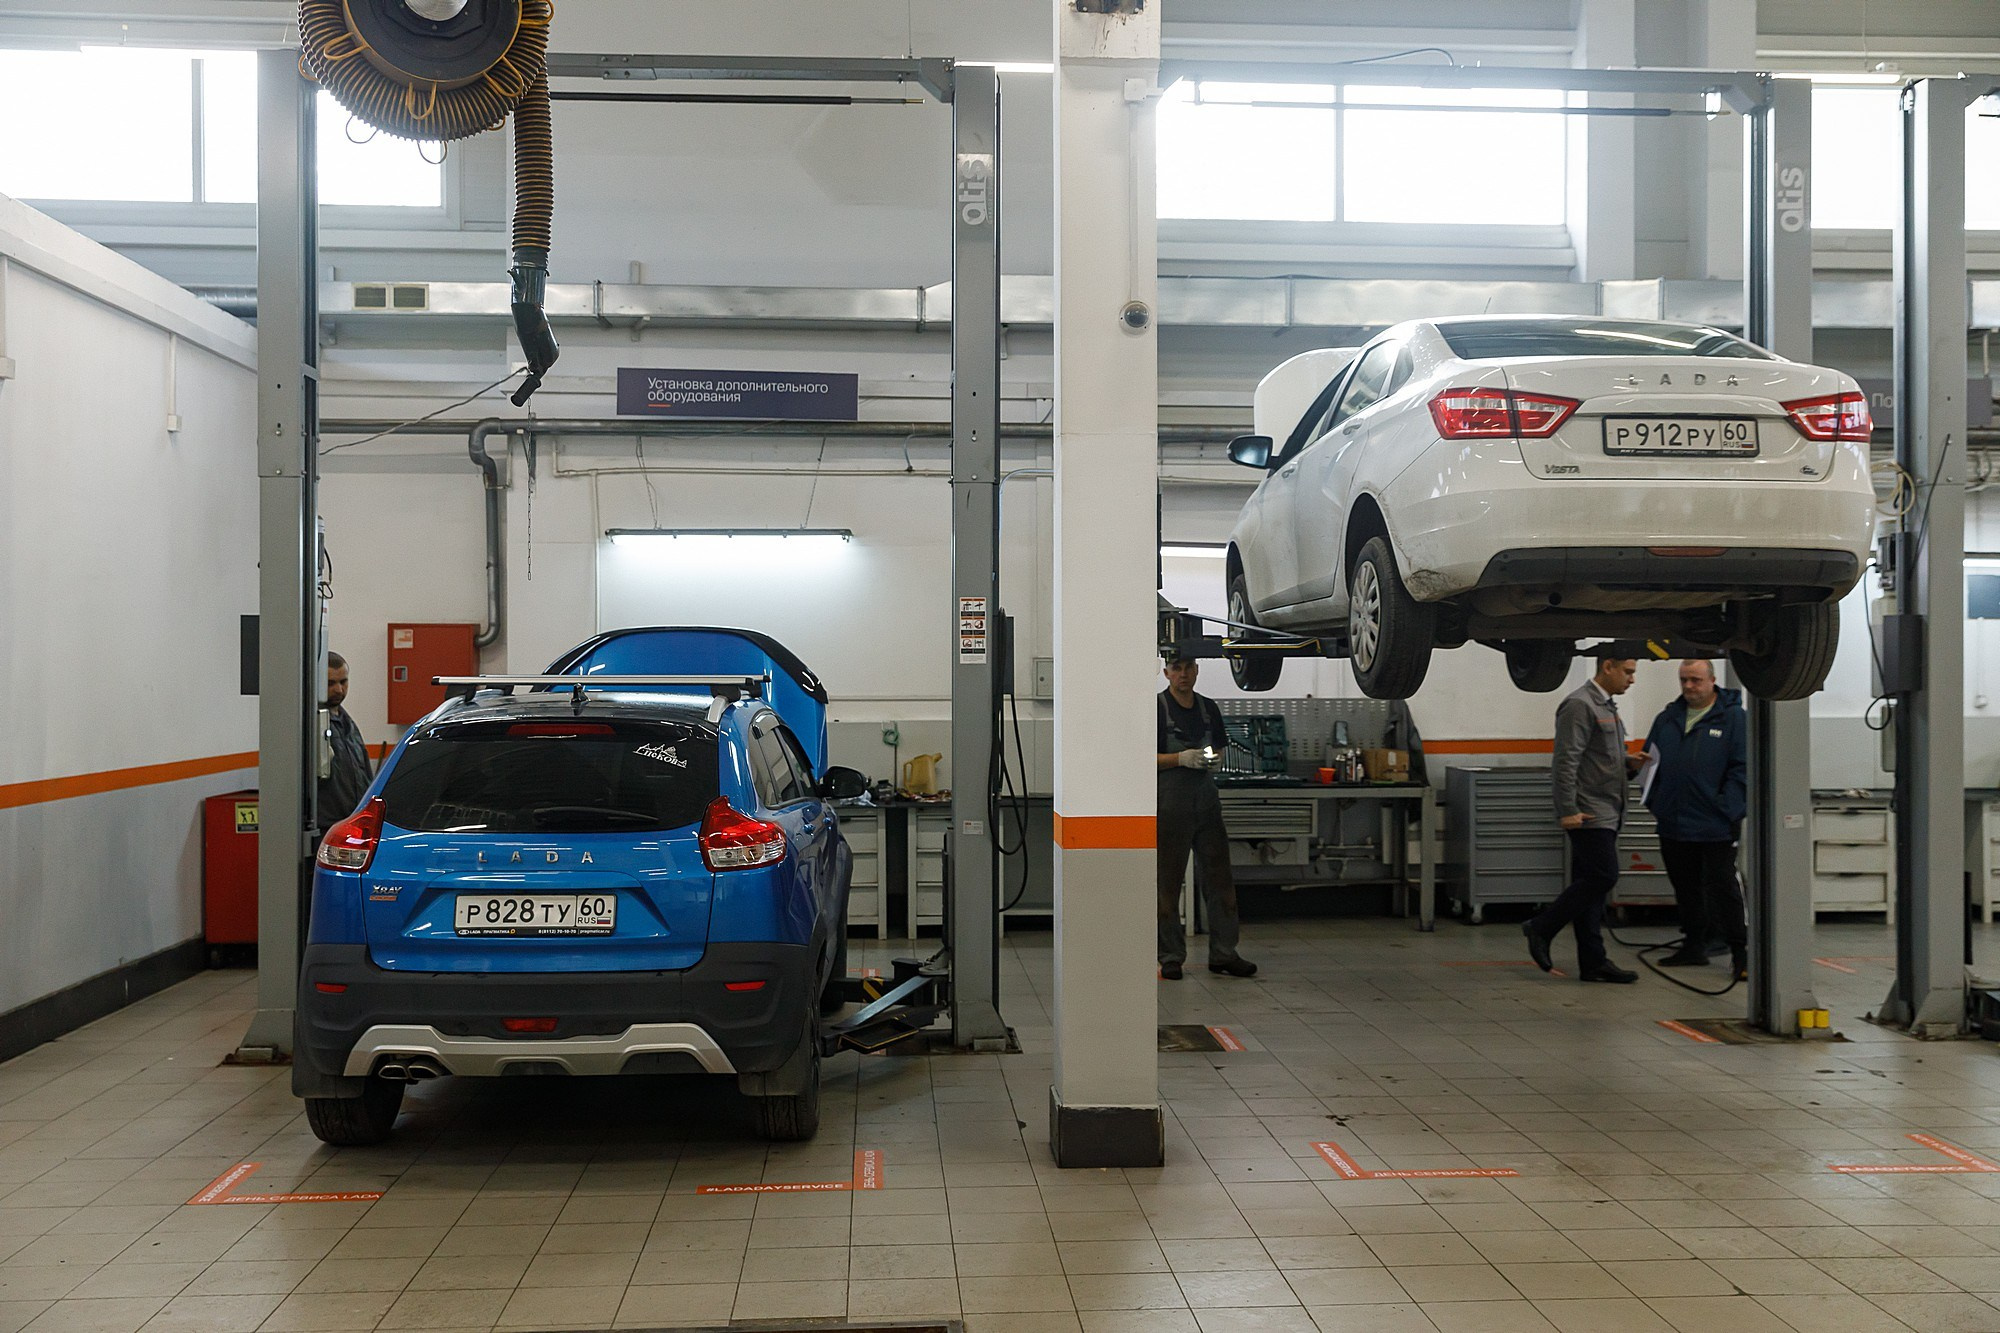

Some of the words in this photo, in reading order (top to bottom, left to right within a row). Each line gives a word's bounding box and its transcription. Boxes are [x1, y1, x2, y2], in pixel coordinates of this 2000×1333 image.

[648, 377, 713, 391] Установка
[716, 381, 829, 394] дополнительного
[1629, 373, 1739, 387] LADA
[647, 390, 741, 403] оборудования
[1724, 423, 1747, 441] 60
[1723, 441, 1741, 449] RUS
[478, 850, 594, 864] LADA
[580, 898, 606, 916] 60
[577, 917, 597, 925] RUS
[706, 1183, 844, 1192] #LADADAYSERVICE
